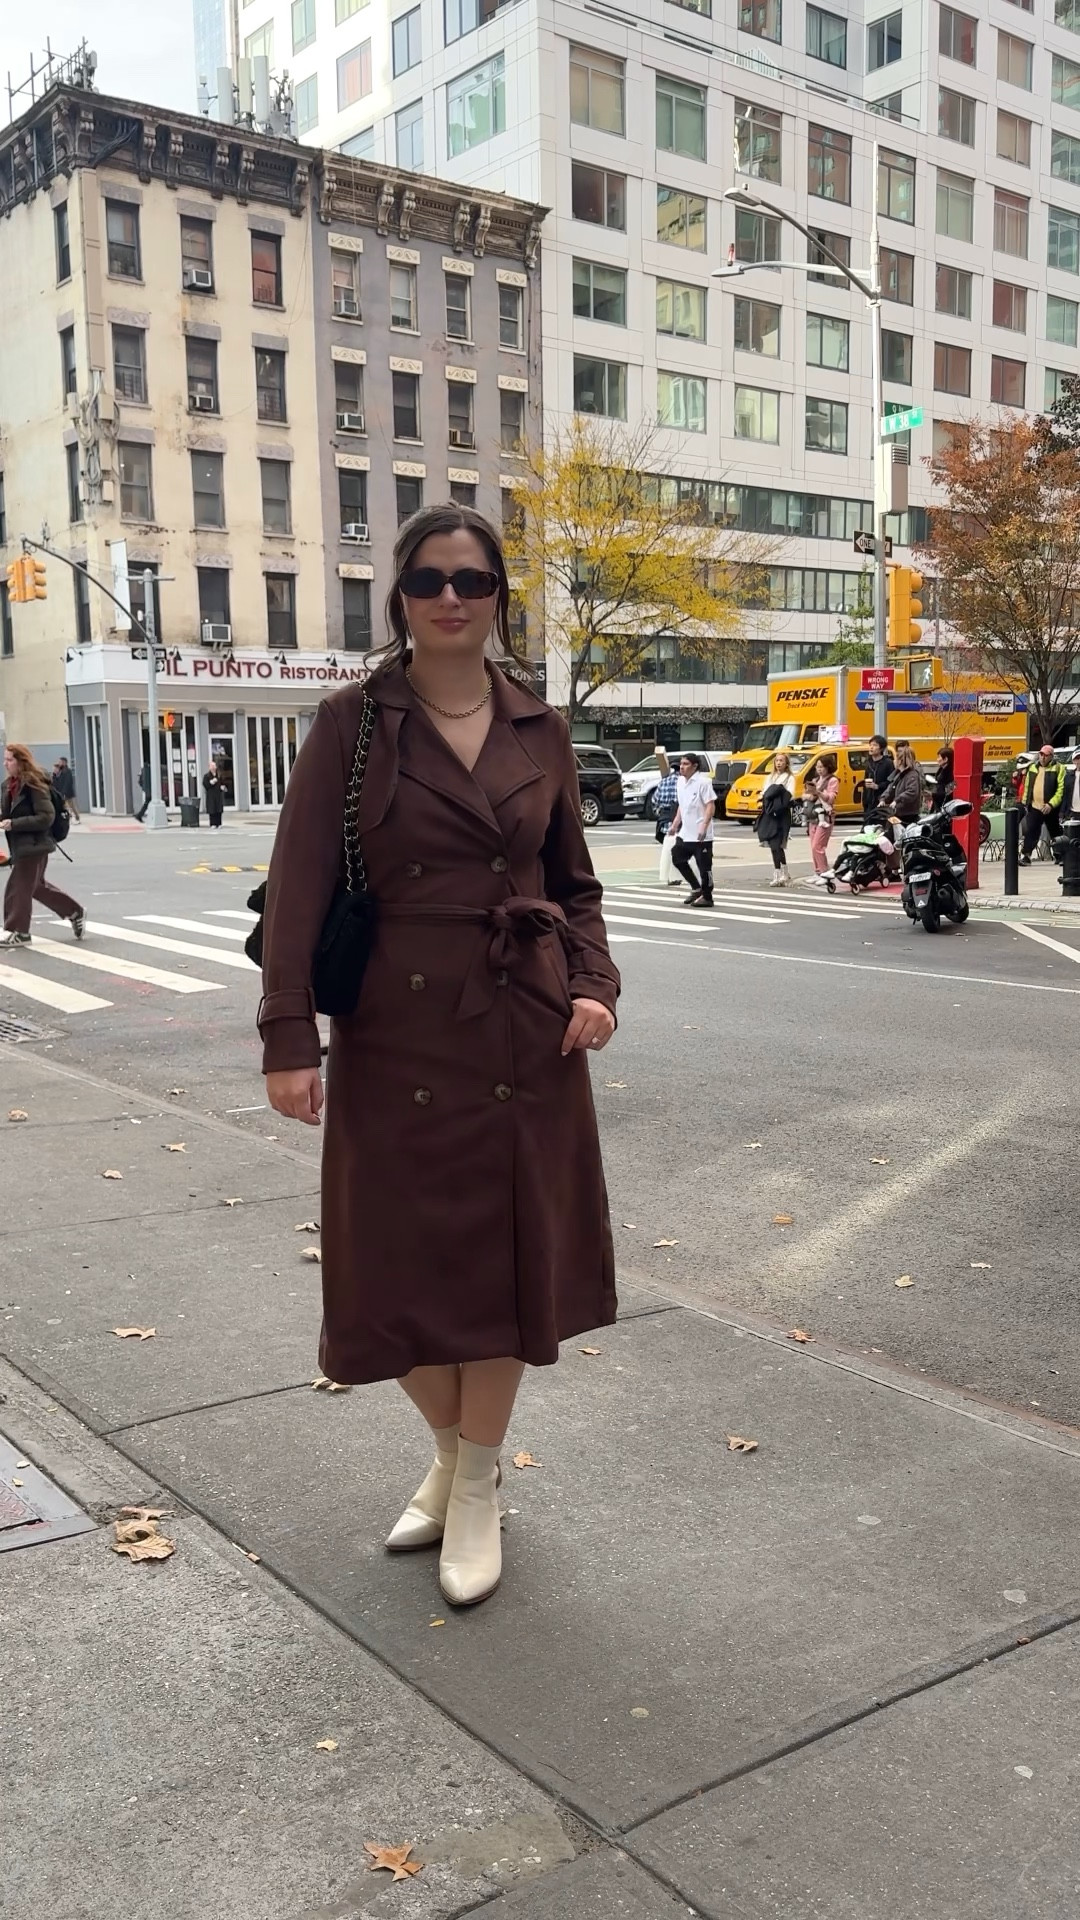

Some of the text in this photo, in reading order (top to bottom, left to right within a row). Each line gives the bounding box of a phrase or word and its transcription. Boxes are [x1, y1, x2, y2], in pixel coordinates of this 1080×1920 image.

[888, 416, 897, 431] W
[899, 413, 909, 428] 38
[859, 538, 872, 549] ONE
[166, 658, 369, 681] IL PUNTO RISTORANT
[509, 669, 546, 682] JONS
[776, 687, 830, 702] PENSKE
[801, 700, 819, 708] Rental
[980, 698, 1012, 708] PENSKE
